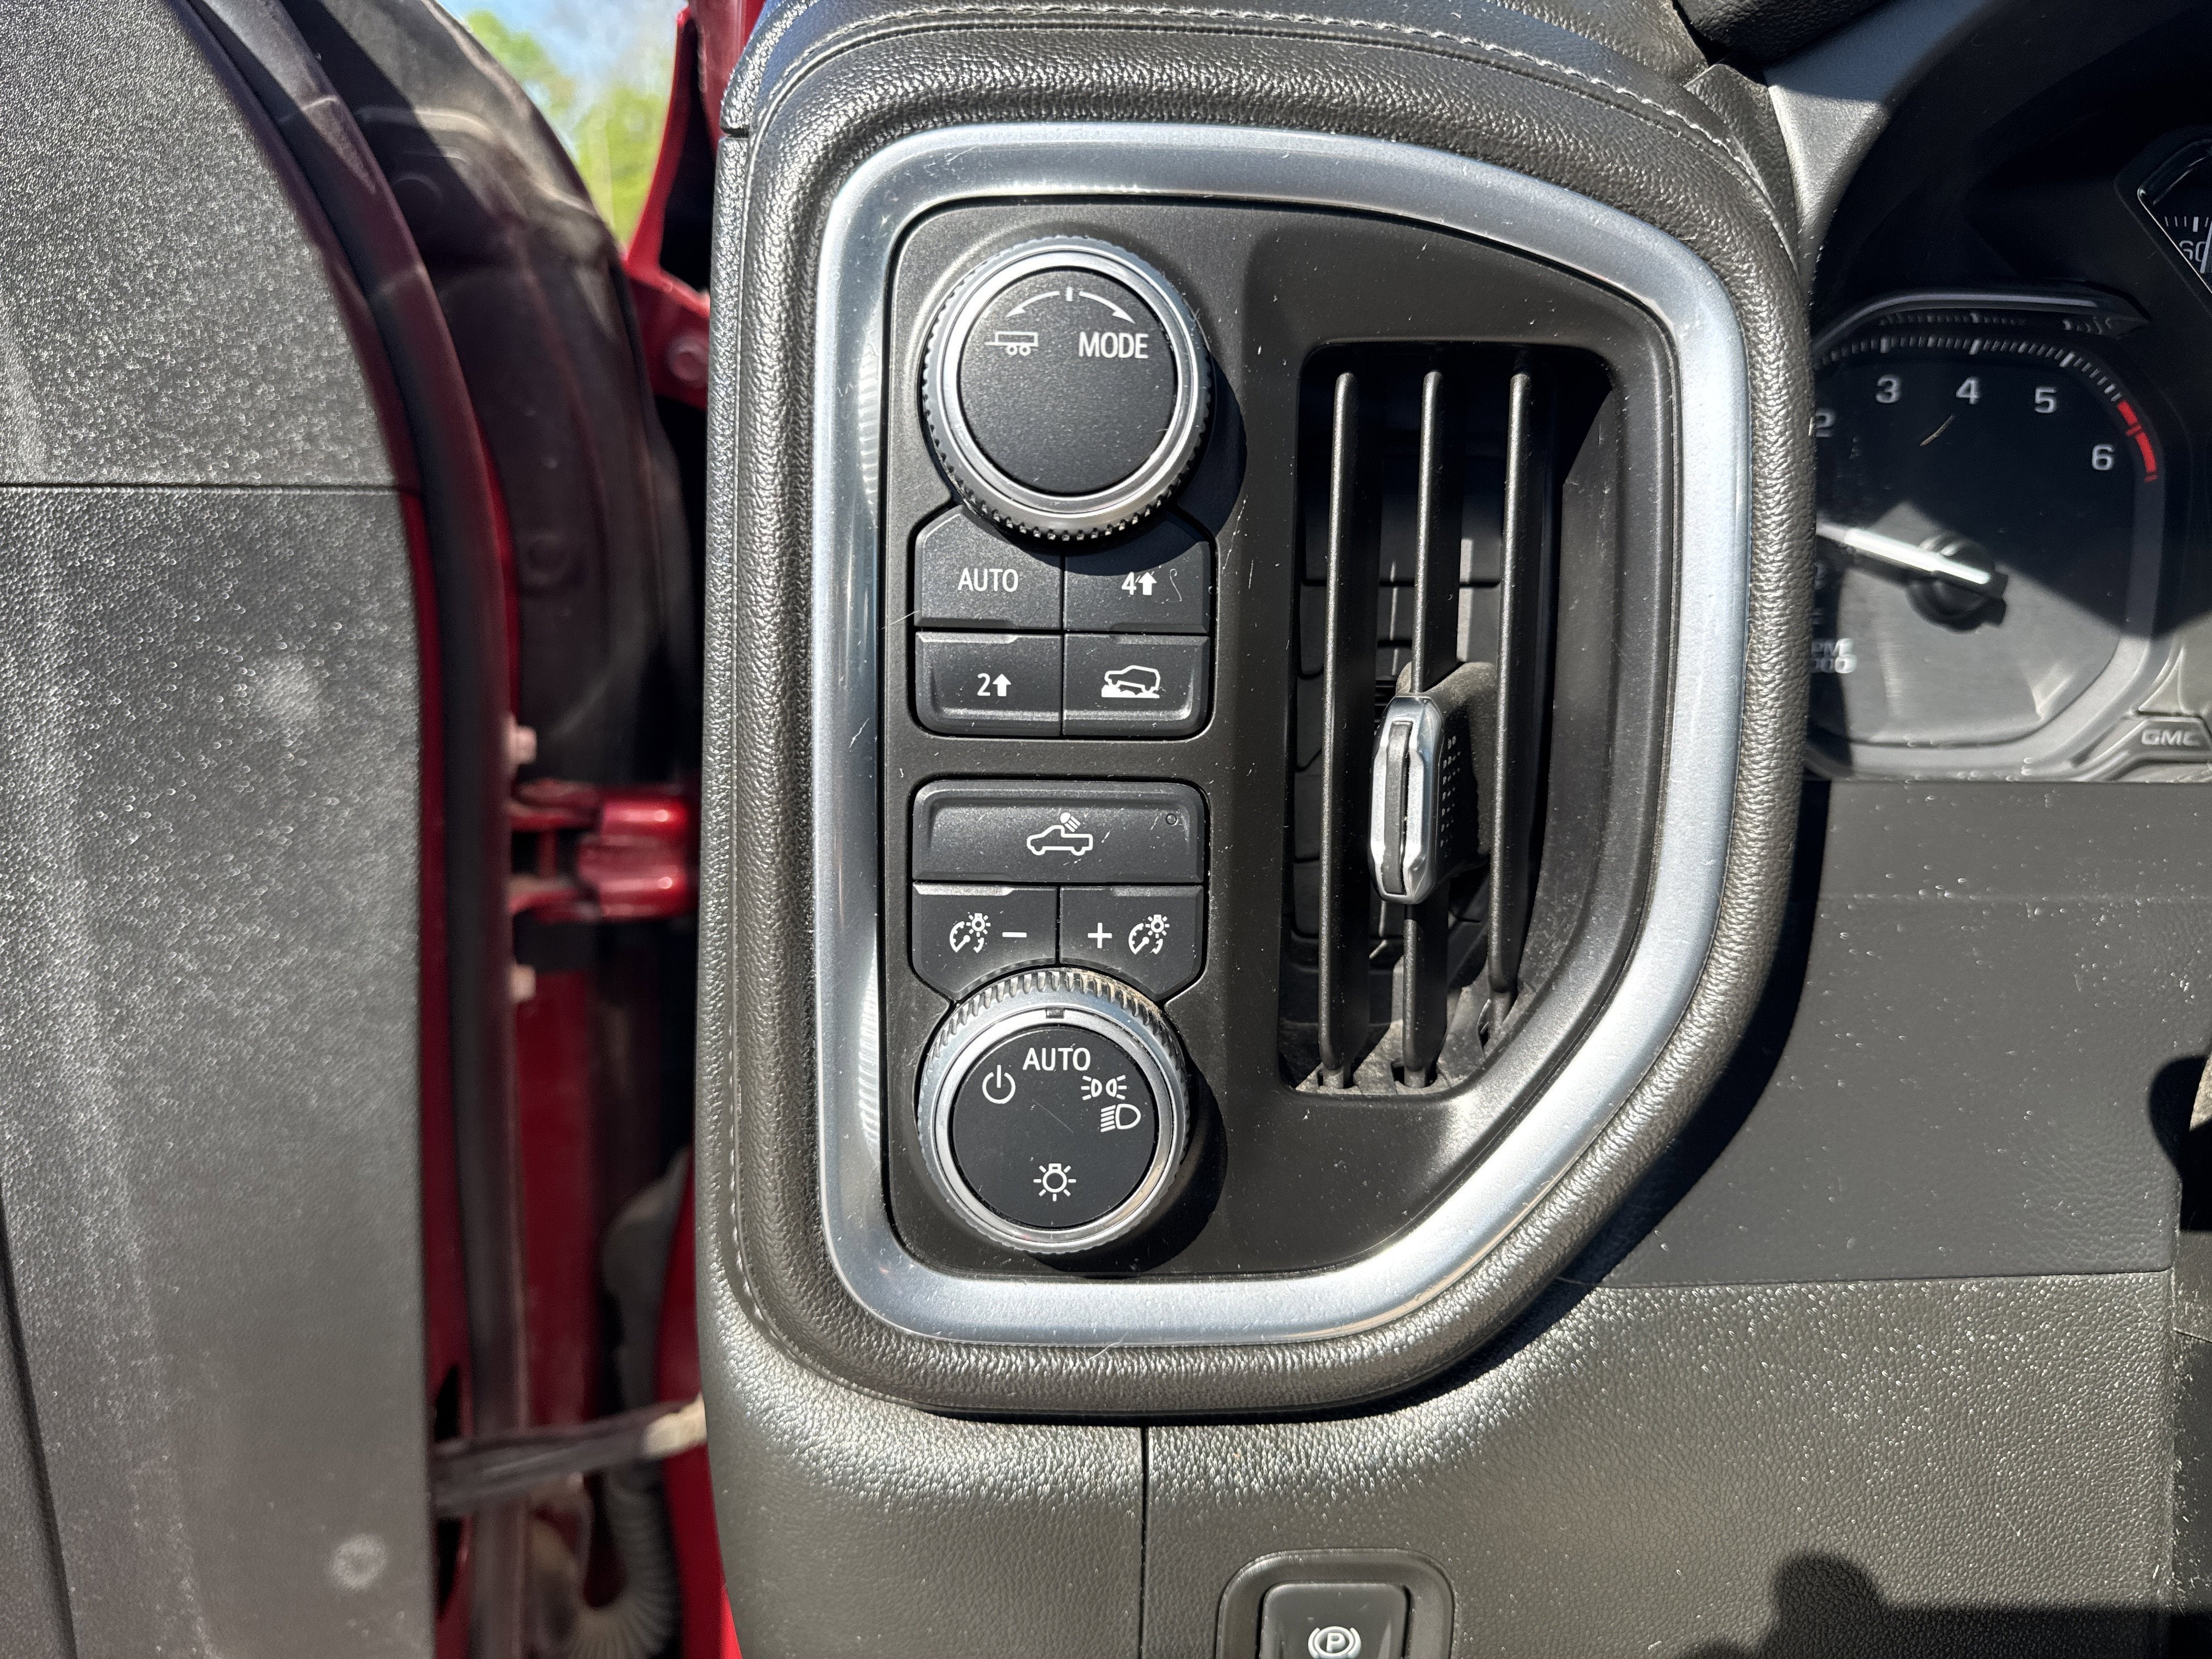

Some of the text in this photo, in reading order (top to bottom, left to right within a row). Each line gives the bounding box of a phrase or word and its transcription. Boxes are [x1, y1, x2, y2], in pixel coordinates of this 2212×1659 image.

[1079, 331, 1149, 359] MODE
[1875, 374, 1901, 404] 3
[1956, 376, 1980, 405] 4
[2034, 386, 2058, 414] 5
[1815, 408, 1836, 438] 2
[2091, 443, 2115, 471] 6
[958, 568, 1019, 591] AUTO
[1121, 572, 1137, 595] 4
[977, 673, 991, 697] 2
[2141, 729, 2201, 747] GMC
[1023, 1047, 1091, 1071] AUTO
